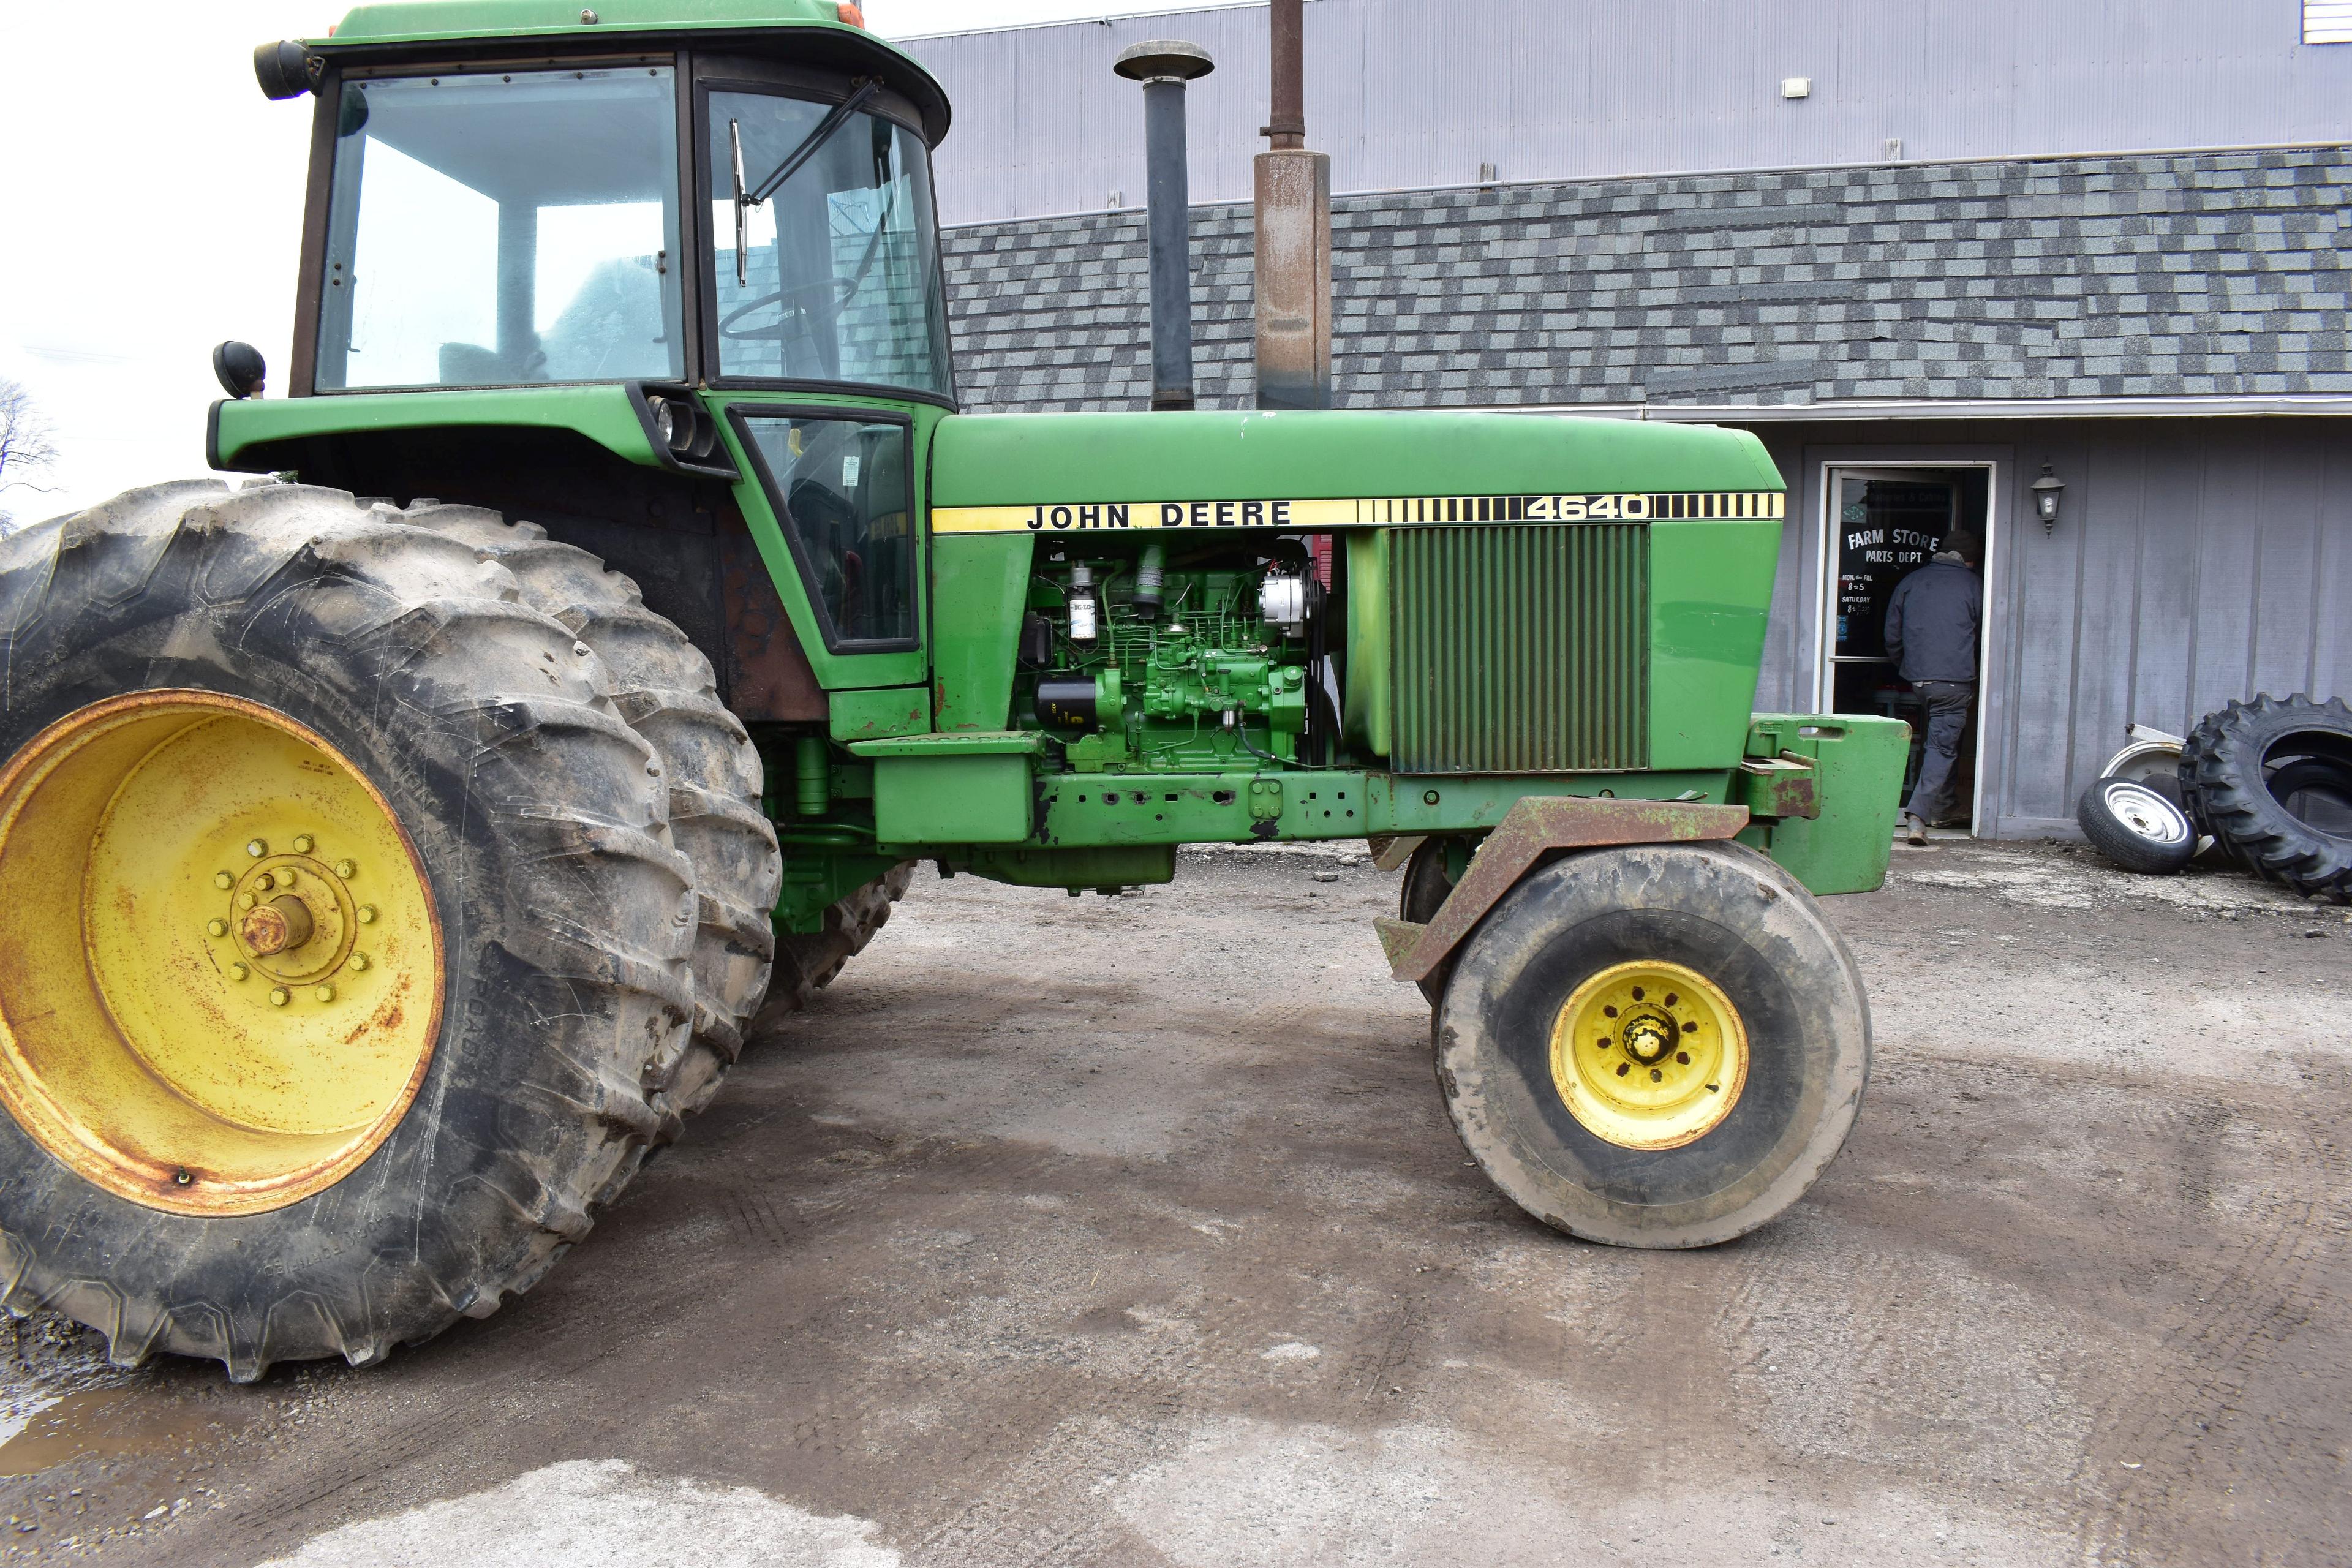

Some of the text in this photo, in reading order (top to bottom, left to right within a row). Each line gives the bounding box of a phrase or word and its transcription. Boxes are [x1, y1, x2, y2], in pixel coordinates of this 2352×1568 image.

[1027, 501, 1291, 529] JOHN DEERE
[1526, 494, 1650, 520] 4640
[1847, 529, 1940, 552] FARM STORE
[1866, 550, 1893, 562] PARTS
[461, 978, 488, 1058] ROAD
